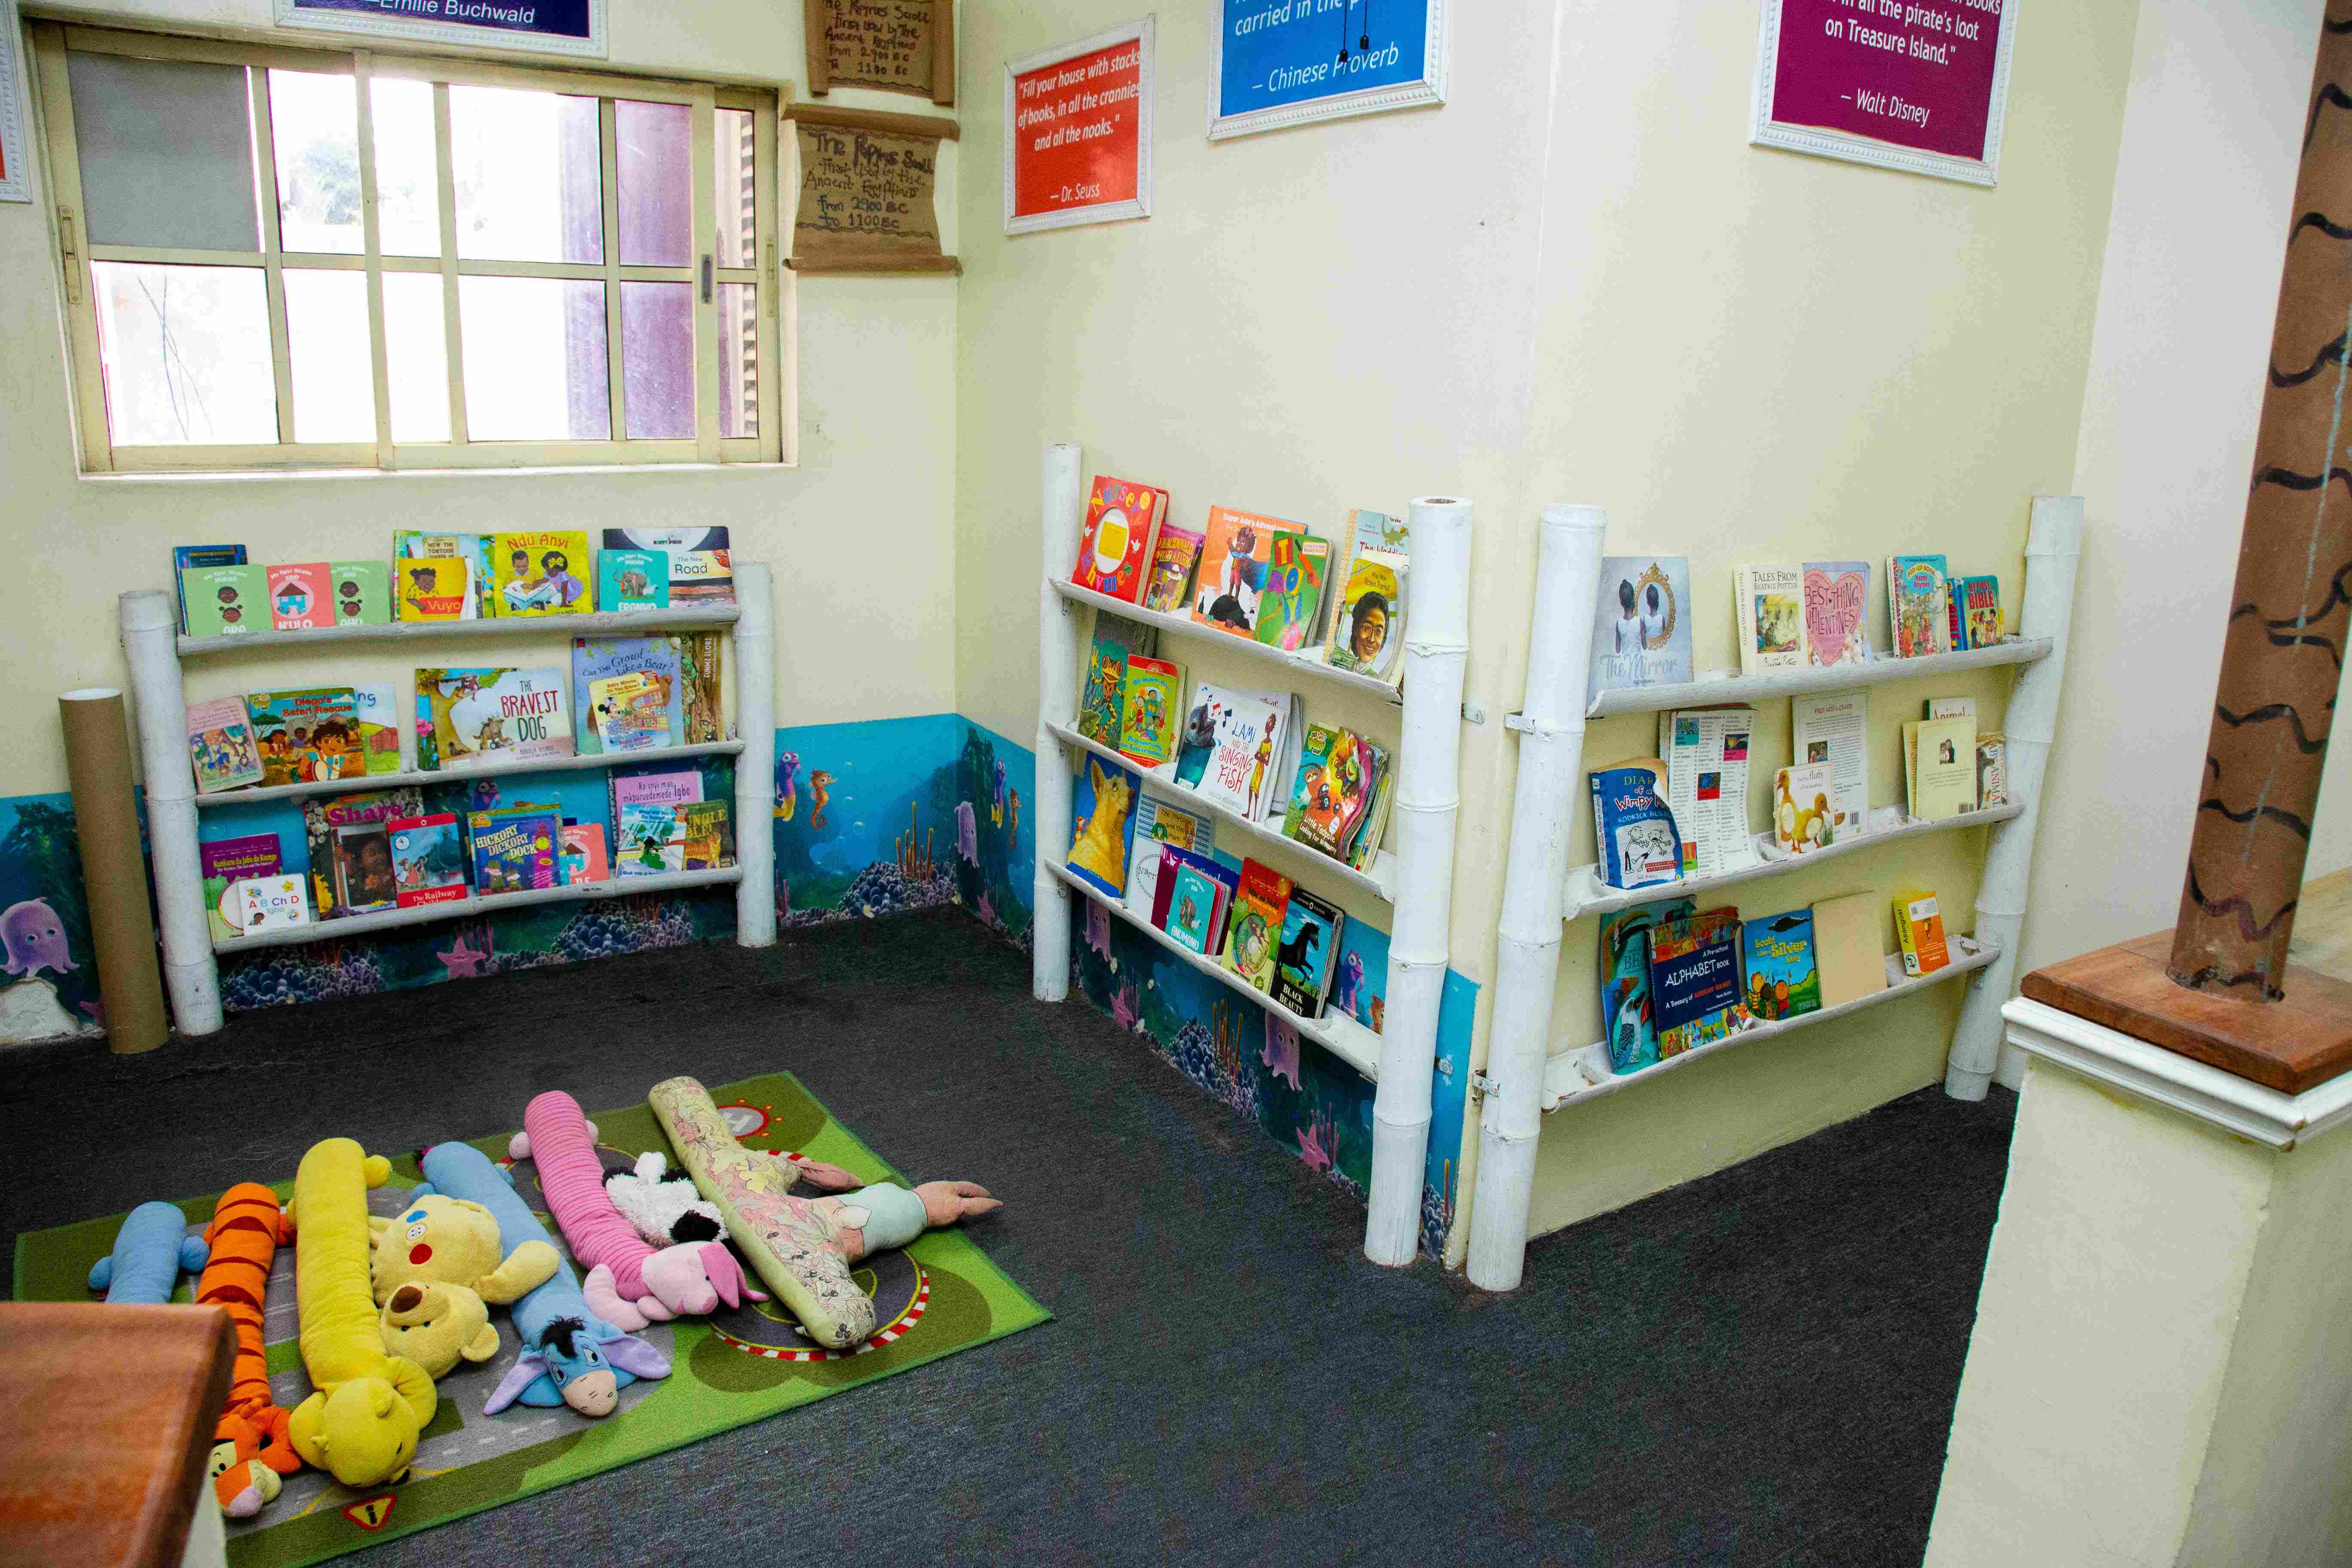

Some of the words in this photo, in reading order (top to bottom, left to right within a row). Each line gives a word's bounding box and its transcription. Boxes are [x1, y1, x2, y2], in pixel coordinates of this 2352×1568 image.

[380, 0, 438, 13] Emilie
[444, 0, 535, 24] Buchwald
[1235, 2, 1290, 36] carried
[1296, 0, 1311, 20] in
[1879, 0, 1902, 19] the
[1905, 3, 1952, 34] pirate's
[1955, 14, 1980, 41] loot
[1825, 18, 1844, 39] on
[1847, 18, 1906, 54] Treasure
[1036, 79, 1057, 98] your
[1058, 69, 1085, 88] house
[1088, 57, 1109, 78] with
[1110, 48, 1140, 74] stacks
[1269, 61, 1329, 92] Chinese
[1018, 109, 1029, 129] of
[1057, 100, 1067, 117] in
[1069, 94, 1081, 114] all
[1082, 91, 1098, 111] the
[1856, 88, 1886, 116] Walt
[1888, 95, 1930, 129] Disney
[1035, 132, 1052, 151] and
[1053, 128, 1065, 147] all
[1066, 124, 1081, 144] the
[1061, 186, 1073, 203] Dr.
[1075, 182, 1100, 201] Seuss
[675, 562, 708, 575] Road
[1752, 571, 1775, 582] TALES
[1777, 570, 1798, 582] FROM
[1754, 582, 1776, 590] BEATRIX
[1804, 586, 1829, 607] BEST
[1830, 582, 1859, 610] THING
[427, 599, 461, 614] Vuyo
[1968, 590, 1995, 610] BIBLE
[582, 669, 597, 677] Can
[597, 665, 611, 674] You
[611, 647, 646, 668] Growl
[1600, 654, 1624, 680] The
[519, 680, 533, 693] THE
[500, 690, 558, 718] BRAVEST
[517, 716, 547, 742] DOG
[674, 784, 691, 800] Igbo
[1623, 776, 1655, 786] DIAR
[1634, 785, 1644, 795] of
[1614, 795, 1654, 812] Wimpy
[475, 824, 518, 848] HICKORY
[1298, 823, 1313, 840] Looking
[1304, 813, 1317, 830] Little
[1317, 824, 1335, 843] Tadpole
[488, 833, 529, 856] DICKORY
[508, 842, 538, 859] DOCK
[248, 900, 257, 909] A
[272, 897, 287, 906] Ch
[291, 895, 299, 904] D
[424, 889, 457, 901] Railway
[1665, 959, 1716, 987] ALPHABET
[1716, 959, 1730, 969] BOOK
[1278, 993, 1305, 1016] BEAUTY
[1283, 983, 1303, 1004] BLACK
[1670, 996, 1689, 1008] Treasury
